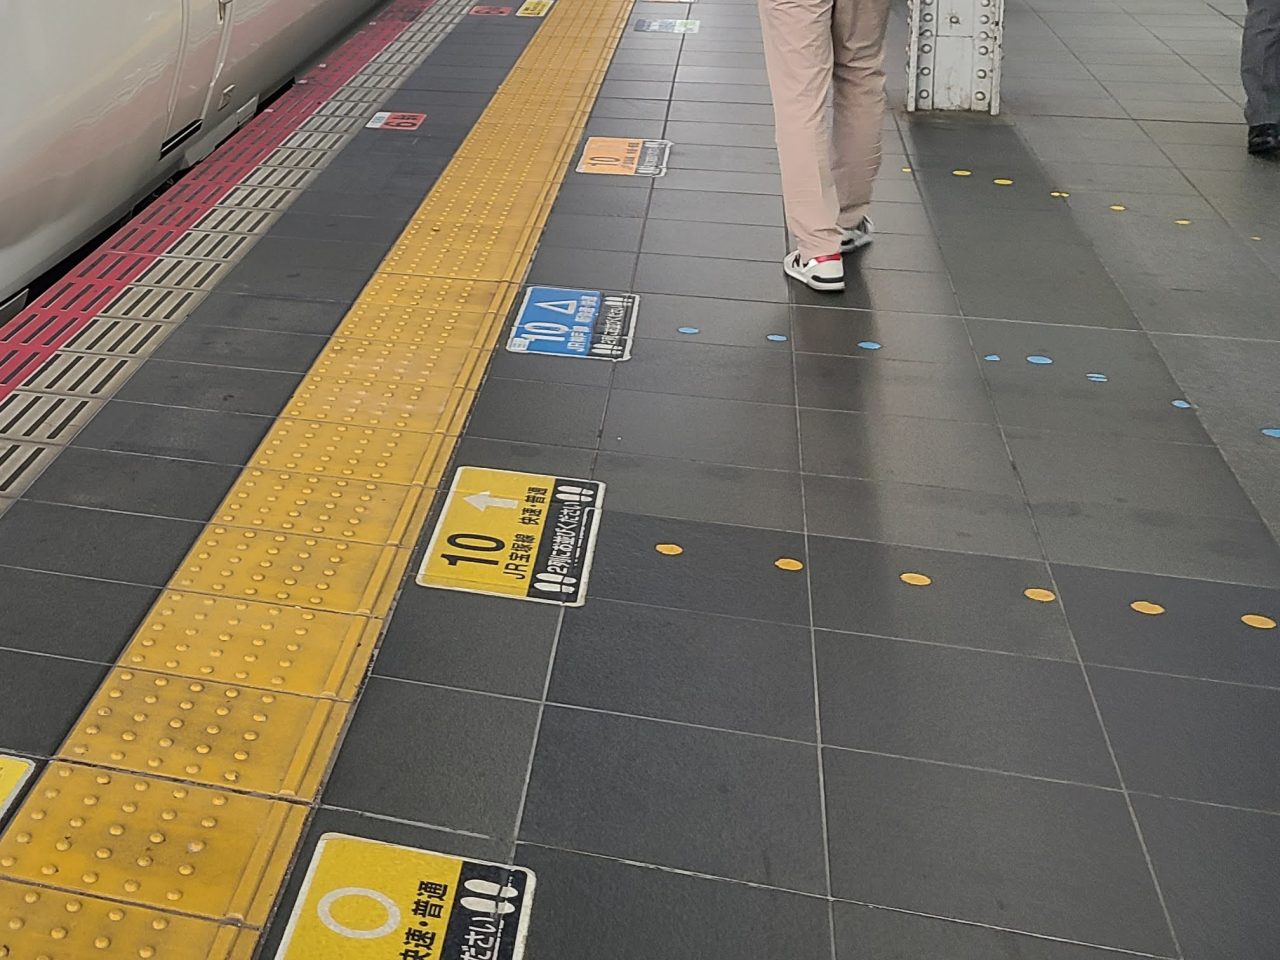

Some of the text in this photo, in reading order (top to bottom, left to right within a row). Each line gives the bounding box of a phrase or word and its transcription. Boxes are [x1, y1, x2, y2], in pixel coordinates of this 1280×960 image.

[587, 156, 621, 167] 10
[520, 321, 571, 342] 10
[440, 532, 506, 567] 10
[503, 486, 549, 580] JR宝塚線 快速・普通
[546, 501, 582, 575] 2列にお並びください
